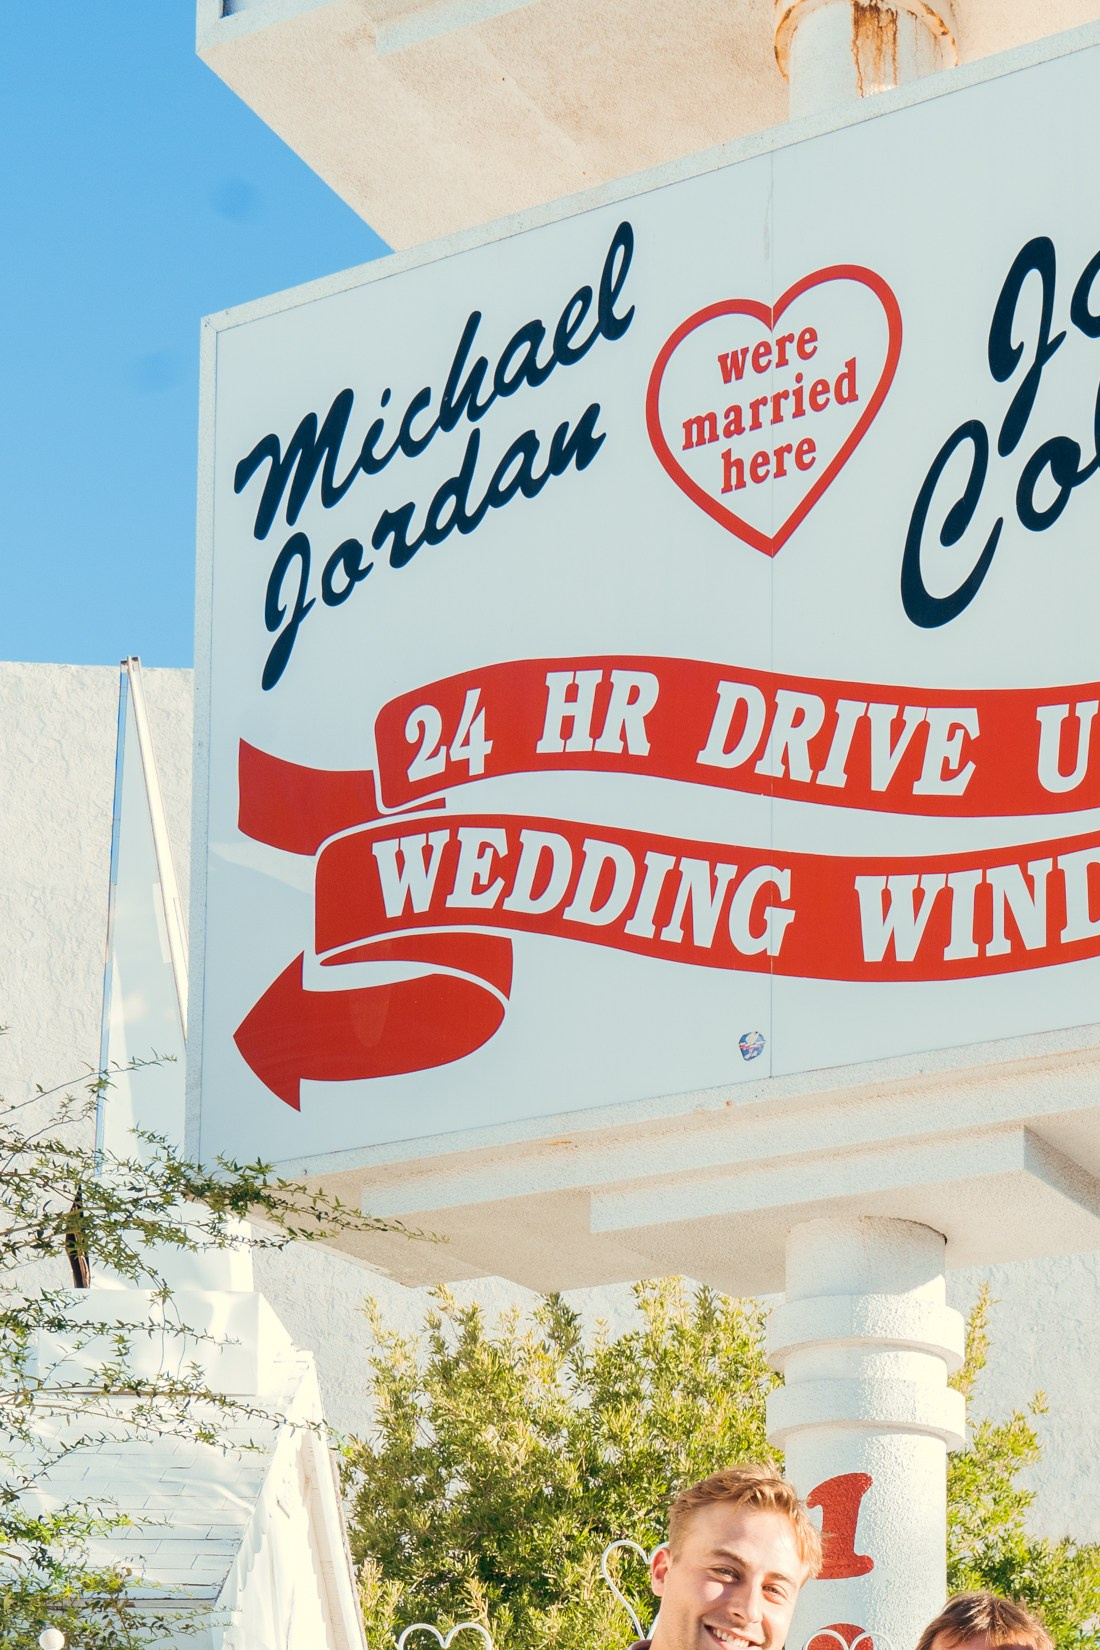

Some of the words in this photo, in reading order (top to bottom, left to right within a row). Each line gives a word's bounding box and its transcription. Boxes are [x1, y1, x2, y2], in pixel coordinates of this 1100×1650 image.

[234, 221, 636, 541] Michael
[682, 357, 858, 450] married
[717, 326, 817, 384] were
[720, 437, 816, 494] here
[261, 402, 607, 692] Jordan
[404, 687, 494, 783] 24
[536, 669, 660, 757] HR
[696, 680, 981, 797] DRIVE
[371, 827, 796, 958] WEDDING
